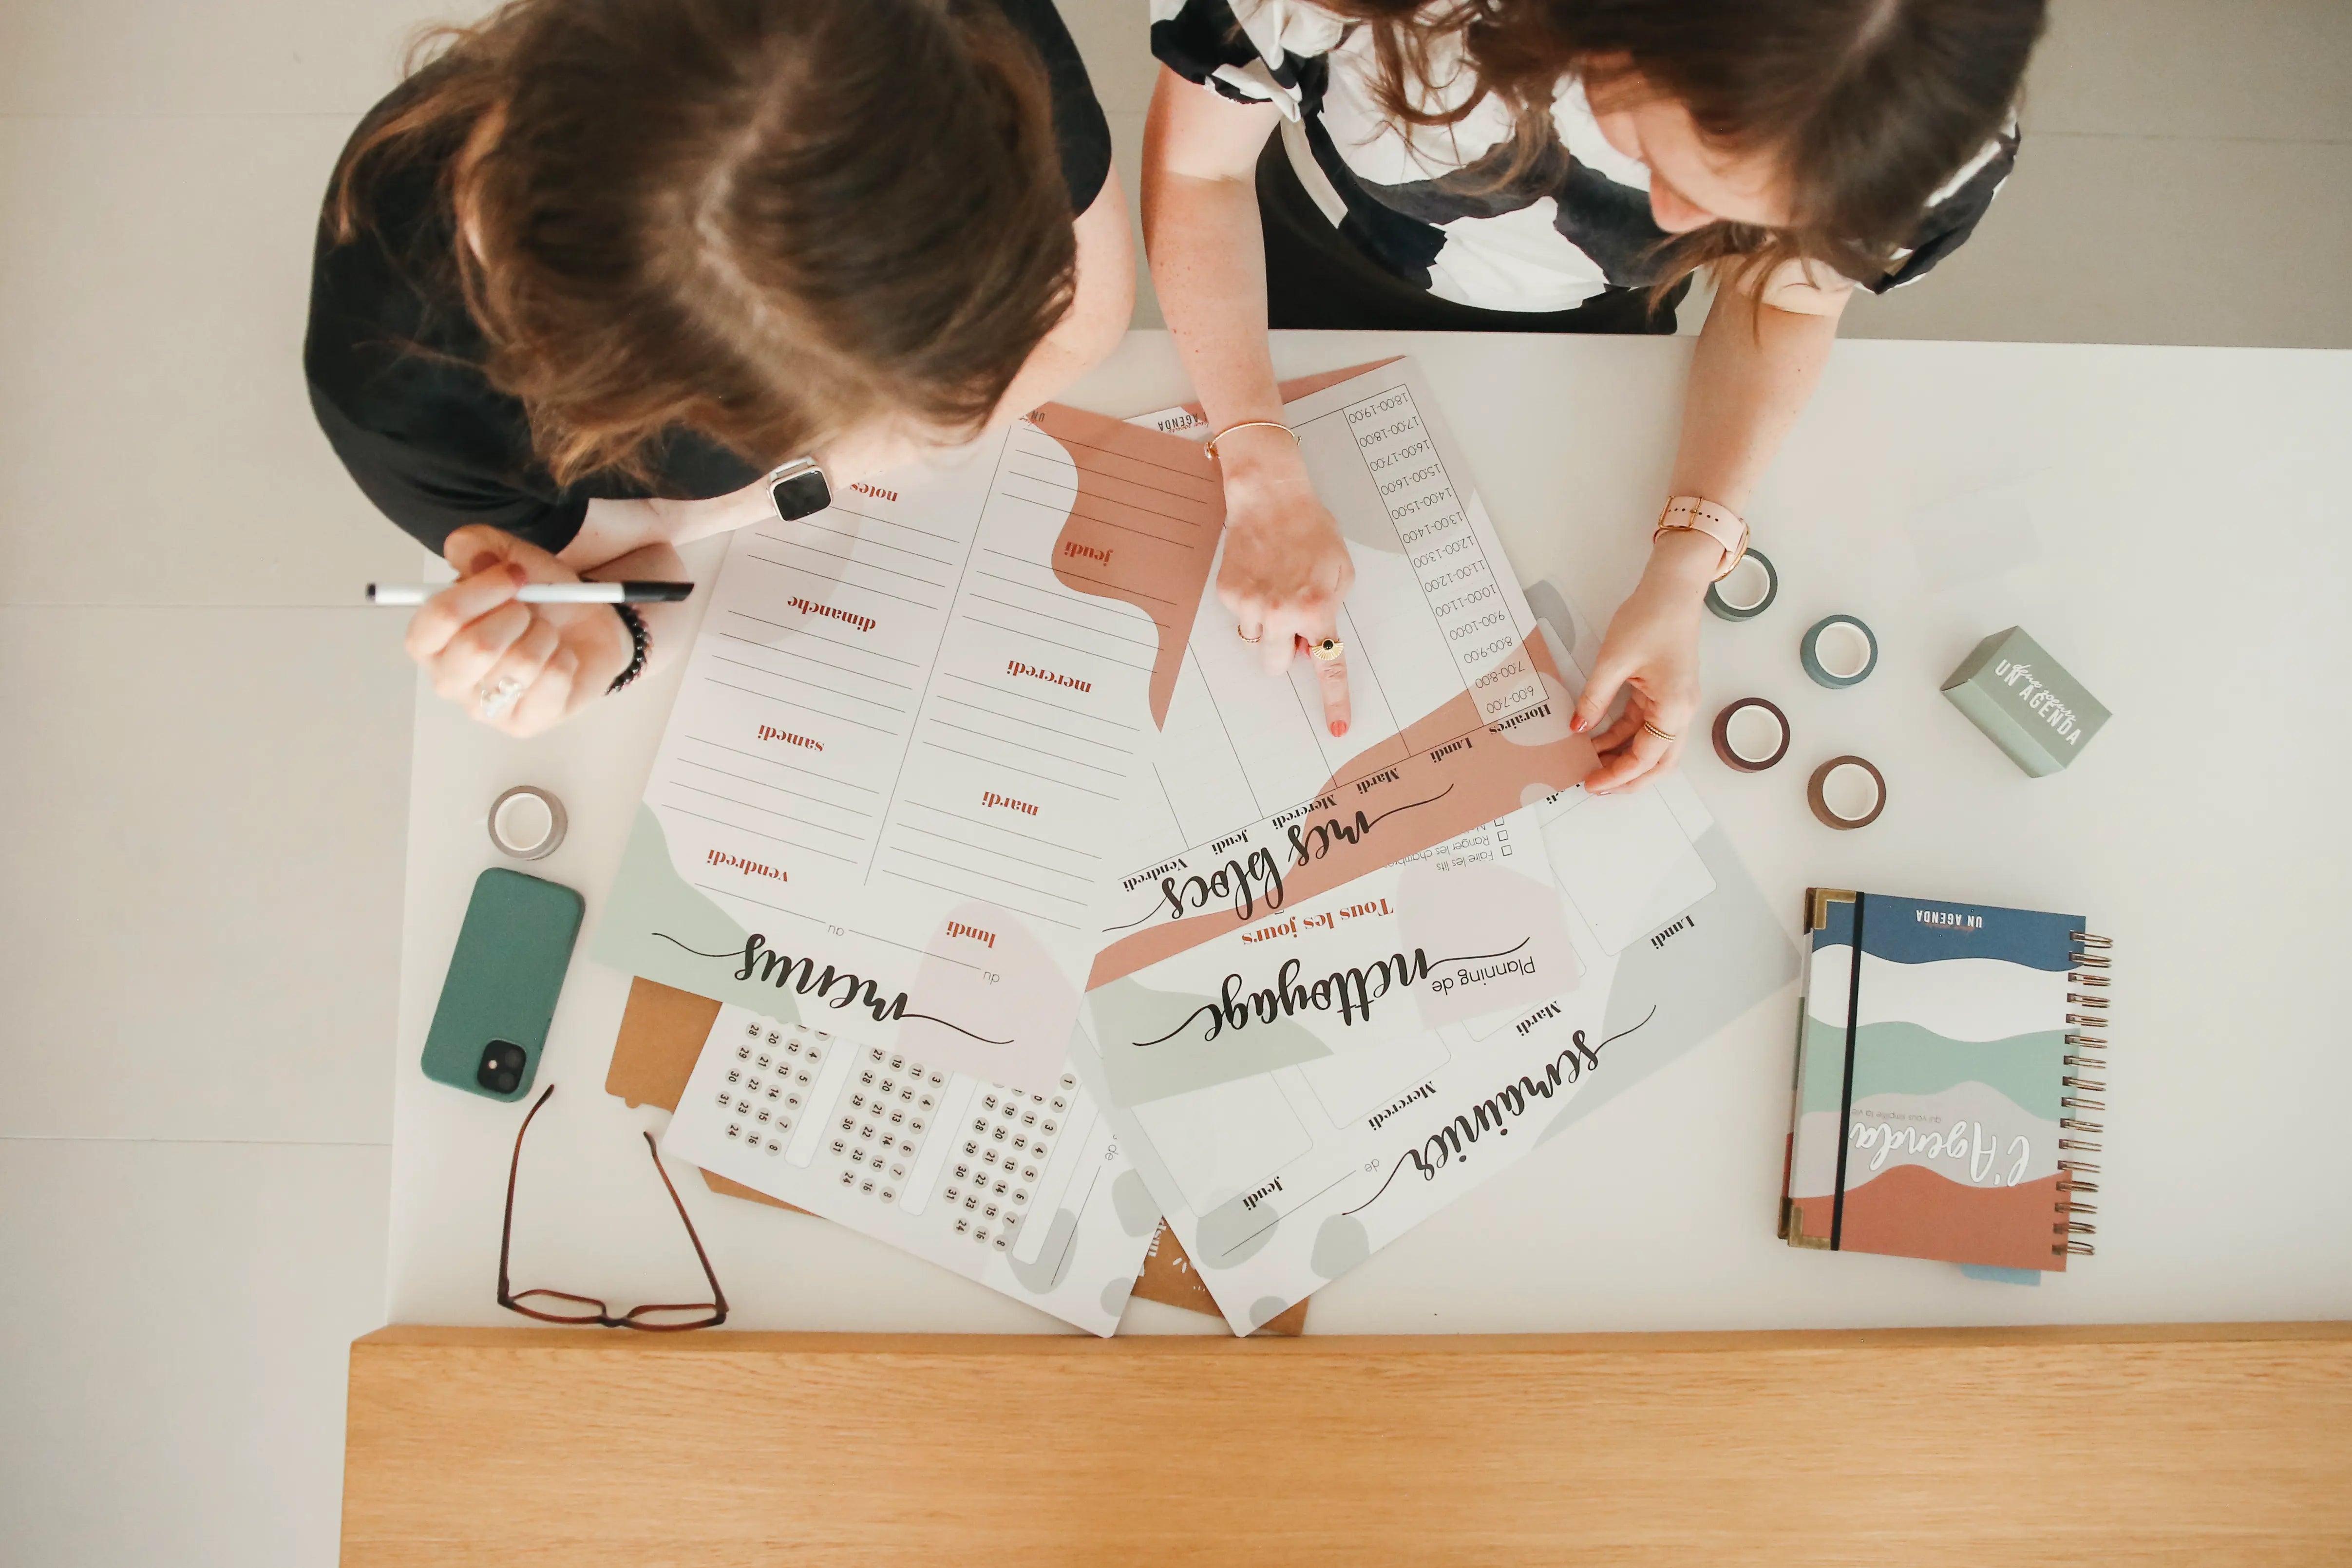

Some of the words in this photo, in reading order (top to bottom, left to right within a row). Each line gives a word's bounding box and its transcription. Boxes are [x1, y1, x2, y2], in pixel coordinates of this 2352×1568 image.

[1348, 393, 1408, 423] 18:00-19:00
[1157, 413, 1198, 432] AGENDA
[1358, 416, 1419, 449] 17:00-18:00
[1371, 439, 1430, 471] 16:00-17:00
[1381, 463, 1442, 495] 15:00-16:00
[851, 483, 898, 502] notes
[1392, 487, 1452, 520] 14:00-15:00
[1403, 511, 1463, 544] 13:00-14:00
[1064, 541, 1114, 567] jeudi
[1414, 535, 1475, 568] 12:00-13:00
[1425, 560, 1485, 592] 11:00-12:00
[1435, 584, 1496, 617] 10:00-11:00
[787, 596, 876, 633] dimanche
[1450, 611, 1505, 640] 9:00-10:00
[1464, 636, 1512, 663] 8:00-9:00
[1007, 660, 1092, 693] mercredi
[1475, 661, 1525, 688] 7:00-8:00
[1486, 686, 1534, 713] 6:00-7:00
[1995, 659, 2022, 686] UN
[2019, 683, 2081, 745] AGENDA
[1489, 703, 1551, 735] Horaires
[758, 725, 824, 752] samedi
[1429, 737, 1473, 763] Lundi
[1356, 767, 1400, 794] Mardi
[982, 791, 1039, 816] mardi
[1271, 793, 1337, 830] Mercredi
[1212, 829, 1249, 855] Jeudi
[1453, 835, 1490, 849] Ranger
[1435, 845, 1450, 855] les
[1468, 850, 1494, 862] Faire
[706, 850, 787, 883] vendredi
[1437, 861, 1450, 871] lits
[1451, 857, 1466, 867] les
[1122, 859, 1188, 892] Vendredi
[1102, 848, 1283, 932] blocs
[1339, 898, 1394, 920] Tous
[1303, 912, 1335, 929] les
[1916, 910, 1962, 926] AGENDA
[1967, 915, 1982, 928] UN
[827, 925, 844, 936] au
[946, 921, 996, 948] lundi
[1241, 916, 1298, 945] jours
[1650, 915, 1695, 949] Lundi
[1458, 956, 1536, 985] Planning
[983, 971, 1000, 985] du
[1432, 978, 1454, 995] de
[1516, 1000, 1562, 1036] Mardi
[748, 1024, 759, 1036] 28
[768, 1033, 779, 1044] 20
[739, 1047, 749, 1058] 29
[788, 1043, 798, 1052] 12
[873, 1049, 883, 1061] 27
[758, 1057, 769, 1067] 21
[891, 1059, 902, 1068] 19
[728, 1071, 739, 1082] 30
[778, 1066, 789, 1075] 13
[911, 1068, 922, 1077] 11
[748, 1078, 759, 1090] 22
[862, 1072, 873, 1084] 28
[882, 1080, 892, 1092] 20
[718, 1094, 729, 1105] 31
[768, 1089, 779, 1098] 14
[901, 1091, 912, 1099] 12
[853, 1095, 863, 1106] 29
[985, 1096, 995, 1108] 27
[1368, 1080, 1437, 1131] Mercredi
[738, 1102, 749, 1114] 23
[872, 1104, 882, 1115] 21
[1005, 1107, 1015, 1116] 19
[1342, 1005, 1656, 1215] semainier
[759, 1112, 769, 1121] 15
[891, 1114, 902, 1123] 13
[1024, 1116, 1034, 1124] 11
[842, 1118, 854, 1130] 30
[975, 1119, 986, 1131] 28
[728, 1125, 739, 1136] 24
[862, 1126, 873, 1137] 22
[995, 1128, 1005, 1139] 20
[748, 1135, 759, 1144] 16
[882, 1136, 892, 1145] 14
[1014, 1138, 1024, 1148] 12
[833, 1141, 843, 1152] 31
[966, 1142, 976, 1154] 29
[1105, 1144, 1119, 1161] de
[852, 1149, 863, 1161] 23
[985, 1152, 995, 1162] 21
[873, 1159, 883, 1169] 15
[1005, 1161, 1015, 1171] 13
[1364, 1159, 1380, 1172] de
[956, 1166, 967, 1177] 30
[843, 1172, 854, 1184] 24
[975, 1173, 986, 1185] 22
[863, 1183, 873, 1191] 16
[995, 1184, 1006, 1193] 14
[946, 1189, 957, 1200] 31
[1242, 1176, 1283, 1211] Jeudi
[966, 1197, 976, 1209] 23
[986, 1207, 996, 1217] 15
[956, 1220, 967, 1231] 24
[976, 1230, 986, 1240] 16
